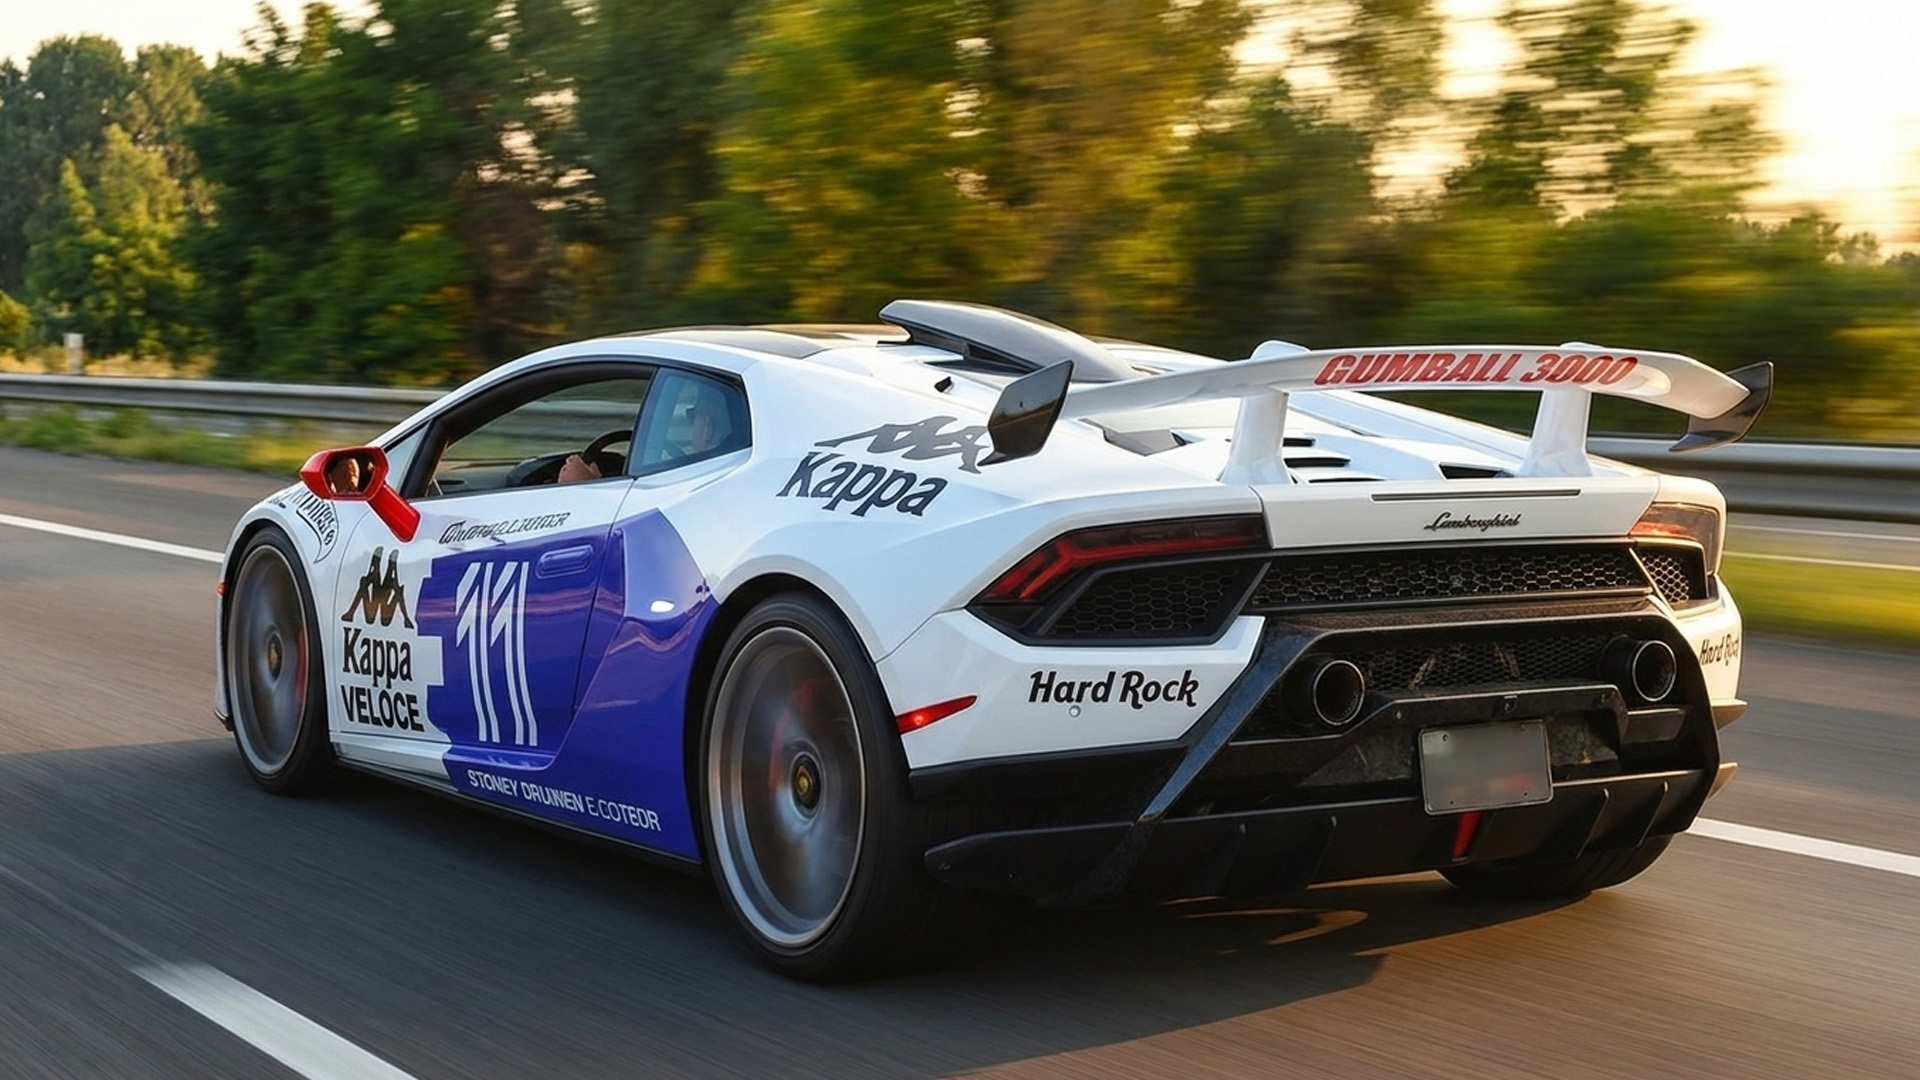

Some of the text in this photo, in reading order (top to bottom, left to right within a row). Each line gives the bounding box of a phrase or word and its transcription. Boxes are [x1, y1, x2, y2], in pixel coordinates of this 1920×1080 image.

[1314, 353, 1638, 385] GUMBALL 3000
[777, 451, 948, 517] Kappa
[342, 626, 413, 689] Kappa
[341, 685, 425, 732] VELOCE
[1028, 669, 1199, 709] Hard Rock
